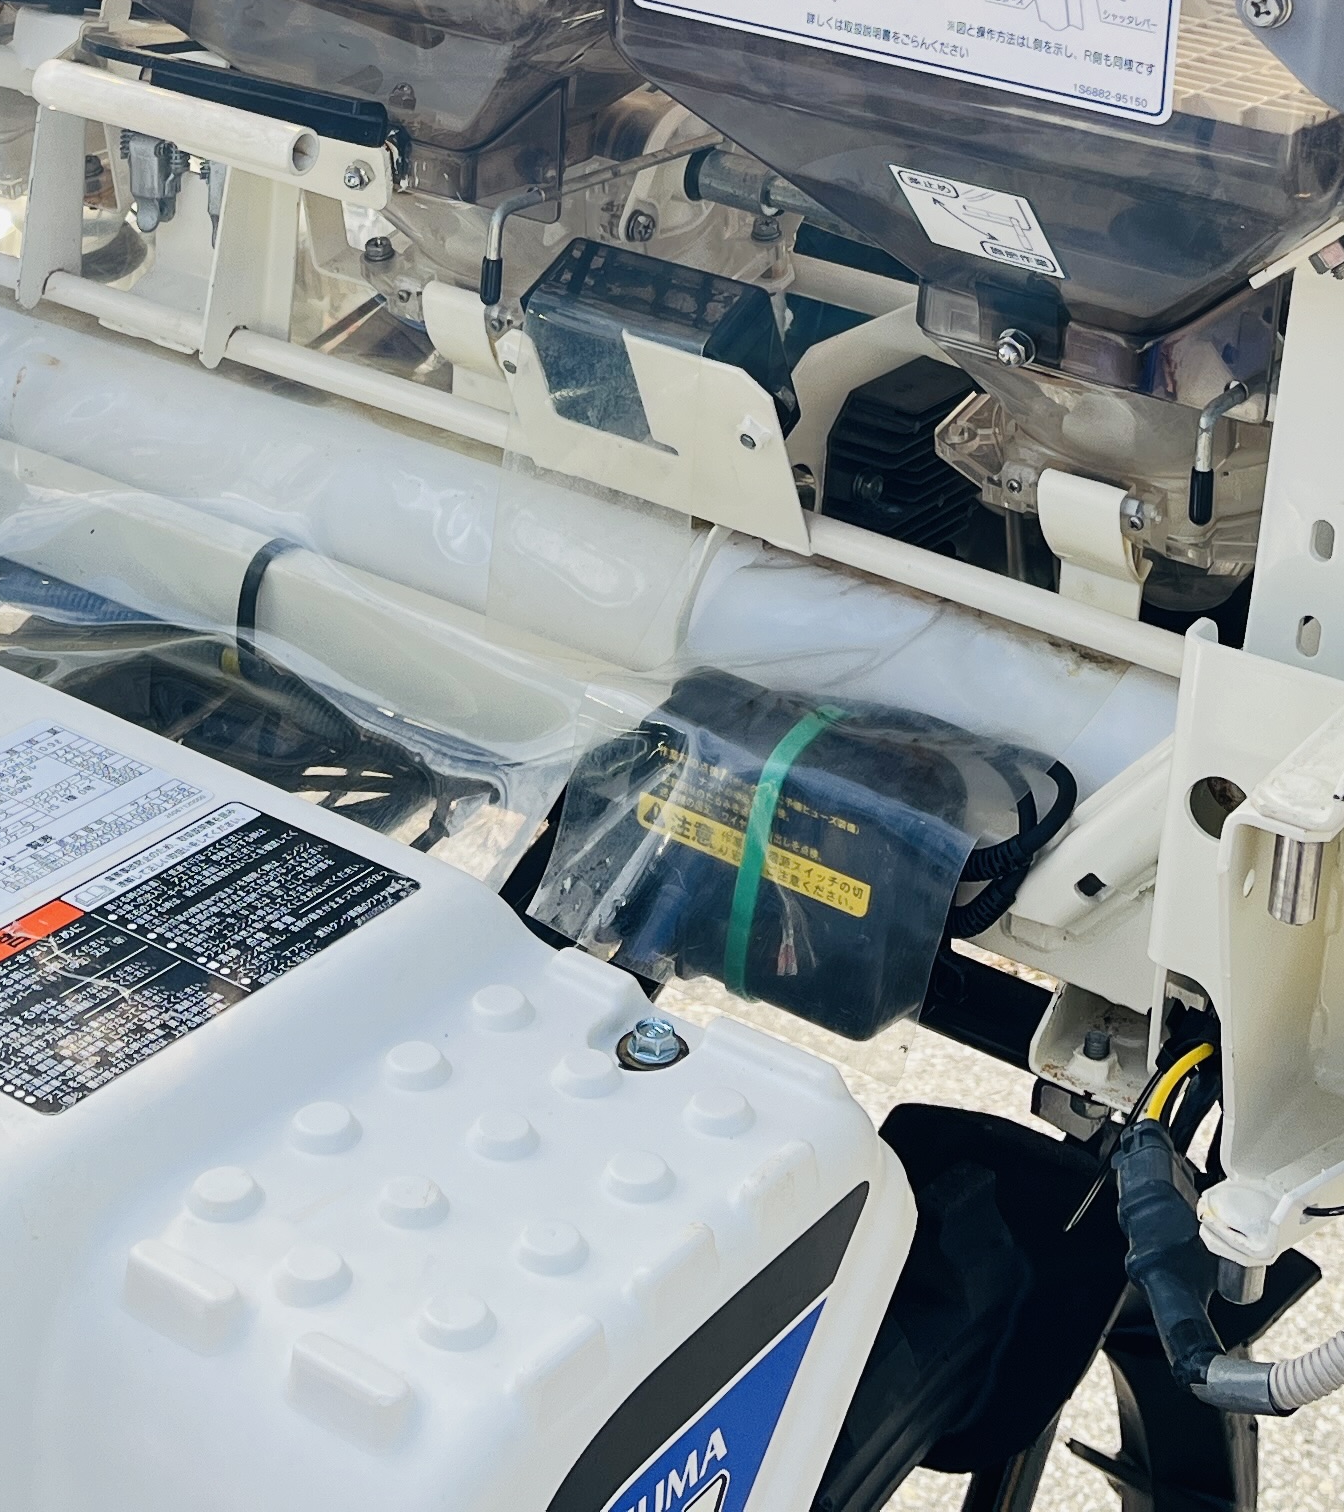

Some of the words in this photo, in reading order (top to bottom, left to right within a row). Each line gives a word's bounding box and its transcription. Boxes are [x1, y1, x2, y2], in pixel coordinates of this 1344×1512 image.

[1102, 10, 1158, 31] シャッタレバー
[1072, 82, 1148, 109] 1S6882-95150
